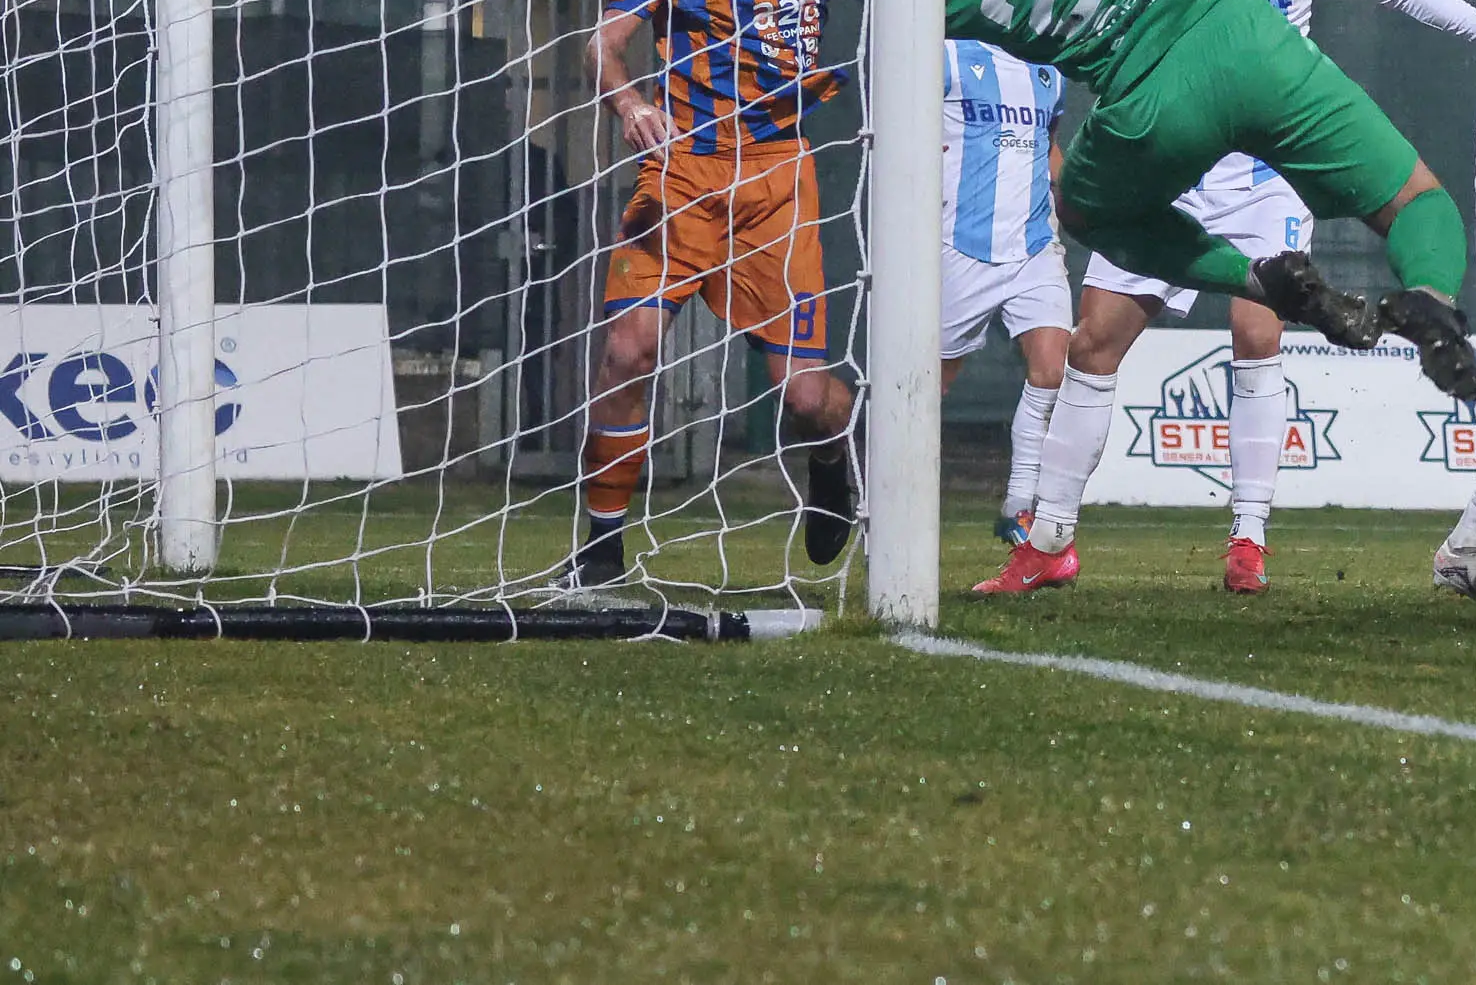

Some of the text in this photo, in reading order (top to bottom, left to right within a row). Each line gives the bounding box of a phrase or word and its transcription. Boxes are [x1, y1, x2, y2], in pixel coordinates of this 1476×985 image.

[1285, 216, 1301, 250] 6
[793, 292, 816, 341] 8
[1160, 424, 1306, 451] STEA
